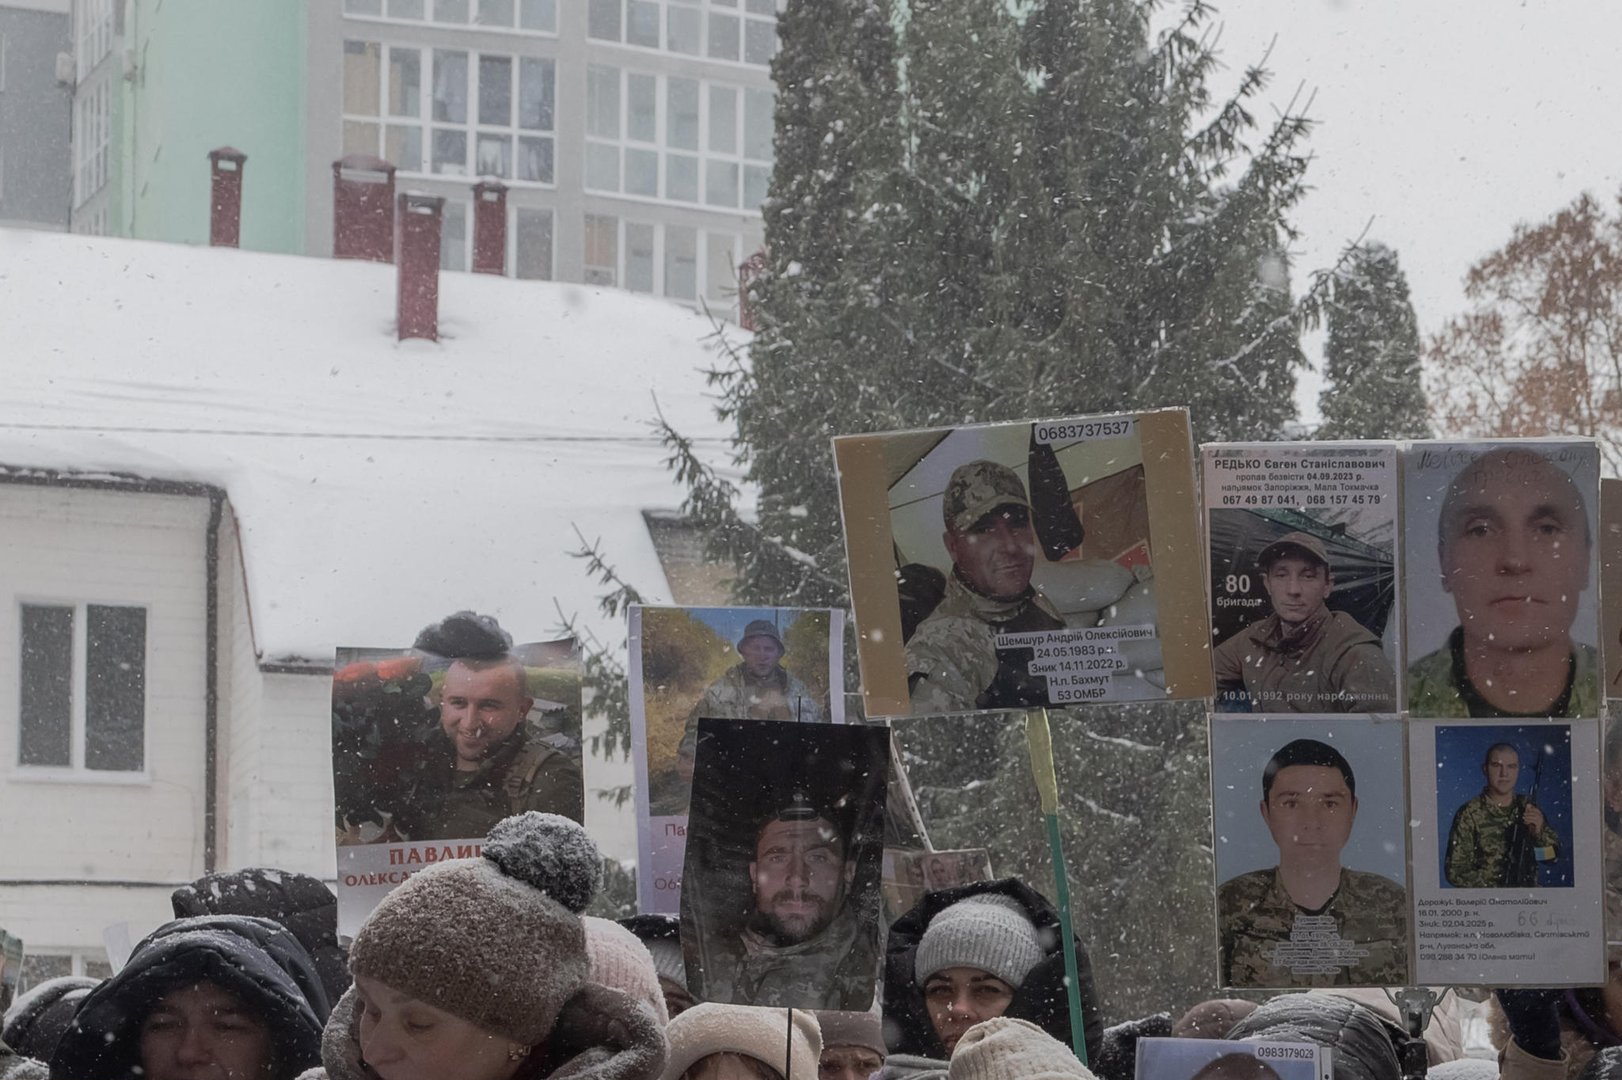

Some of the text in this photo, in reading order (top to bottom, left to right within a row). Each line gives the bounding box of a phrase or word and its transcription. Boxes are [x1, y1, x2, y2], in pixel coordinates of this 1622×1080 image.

[1039, 421, 1129, 440] 0683737537
[1214, 458, 1386, 470] РЕДЬКО Євген Станіславович
[1222, 496, 1242, 504] 067
[1225, 574, 1251, 593] 80
[1216, 597, 1261, 607] бригада
[998, 628, 1153, 647] Шемшур Андрій Олексійович
[1037, 645, 1095, 659] 24.05.1983
[1031, 663, 1057, 674] Зник
[1059, 660, 1114, 673] 14.11.2022
[1071, 674, 1110, 686] Бахмут
[1057, 688, 1106, 700] 53 ОМБР
[1286, 692, 1313, 702] року
[665, 824, 687, 836] Па
[345, 870, 420, 886] ОЛЕКСА
[1258, 1047, 1314, 1059] 0983179029
